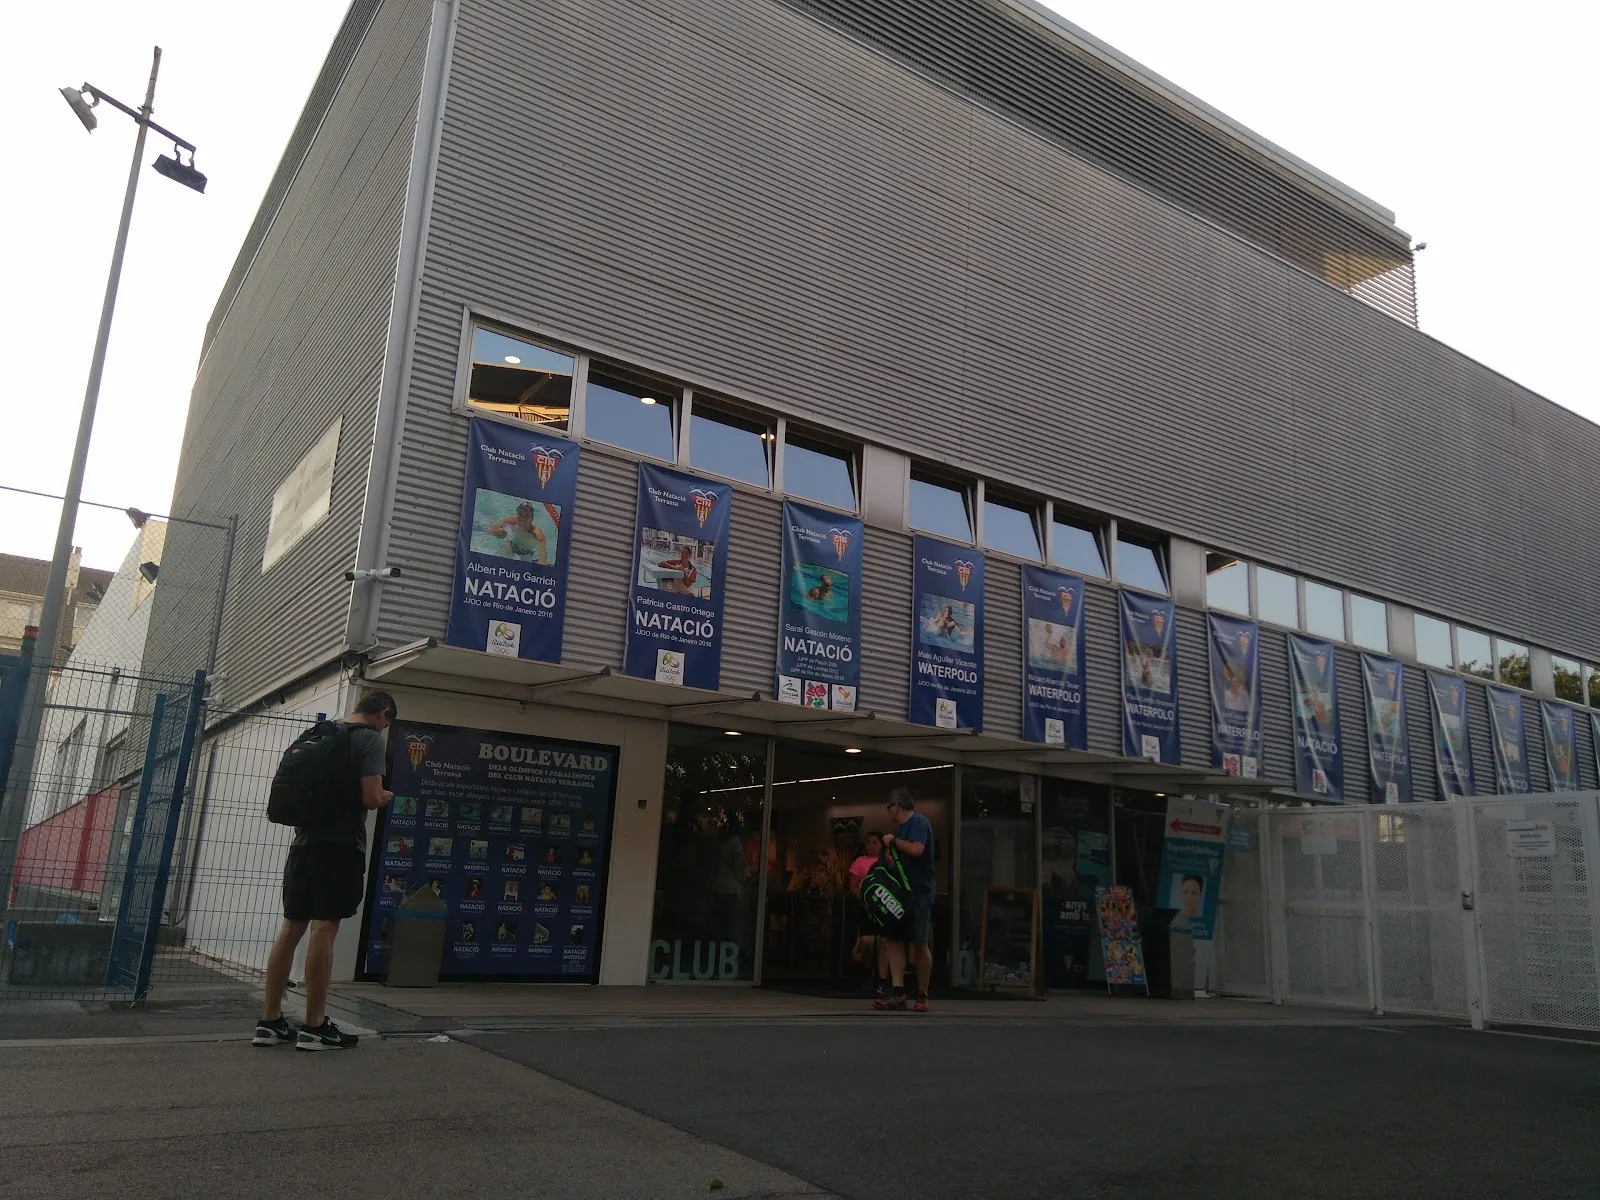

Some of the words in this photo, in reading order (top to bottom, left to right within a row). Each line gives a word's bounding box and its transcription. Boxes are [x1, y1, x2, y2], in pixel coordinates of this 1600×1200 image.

[480, 444, 497, 454] Club
[498, 448, 525, 460] Natació
[488, 453, 516, 466] Terrassa
[537, 454, 556, 466] CTN
[648, 487, 661, 495] Club
[663, 491, 686, 501] Natació
[655, 496, 679, 507] Terrassa
[696, 497, 711, 507] CTN
[791, 525, 805, 533] Club
[806, 528, 826, 539] Natació
[798, 533, 820, 544] Terrassa
[922, 558, 934, 566] Club
[467, 562, 496, 575] Albert
[498, 568, 520, 581] Puig
[523, 572, 556, 586] Garrich
[465, 577, 556, 608] NATACIÓ
[464, 597, 481, 606] JJOO
[483, 600, 491, 608] de
[515, 606, 536, 616] Janeiro
[538, 610, 553, 618] 2016
[637, 595, 664, 607] Patricia
[666, 602, 690, 612] Castro
[691, 606, 715, 618] Ortega
[636, 609, 714, 638] NATACIÓ
[660, 632, 670, 640] Rio
[678, 637, 697, 645] Janeiro
[785, 623, 804, 633] Sarai
[805, 626, 827, 638] Gascón
[829, 632, 852, 643] Moreno
[784, 636, 853, 662] NATACIÓ
[933, 653, 954, 664] Aguilar
[955, 658, 977, 669] Vicente
[918, 661, 977, 684] WATERPOLO
[1028, 684, 1080, 703] WATERPOLO
[1126, 701, 1175, 720] WATERPOLO
[478, 743, 608, 772] BOULEVARD
[425, 760, 442, 769] Club
[443, 762, 471, 771] Natació
[488, 764, 507, 772] DELS
[509, 765, 544, 775] OLÍMPICS
[549, 770, 596, 781] PARALÍMPICS
[432, 769, 462, 778] Terrassa
[504, 773, 523, 782] CLUB
[525, 775, 557, 785] NATACIÓ
[558, 778, 594, 788] TERRASSA
[421, 779, 445, 787] Dedicat
[446, 780, 455, 788] als
[420, 788, 433, 797] que
[448, 789, 464, 798] estat
[874, 886, 905, 920] arena
[1065, 900, 1088, 912] anys
[1060, 910, 1081, 921] amb
[648, 939, 739, 981] CLUB
